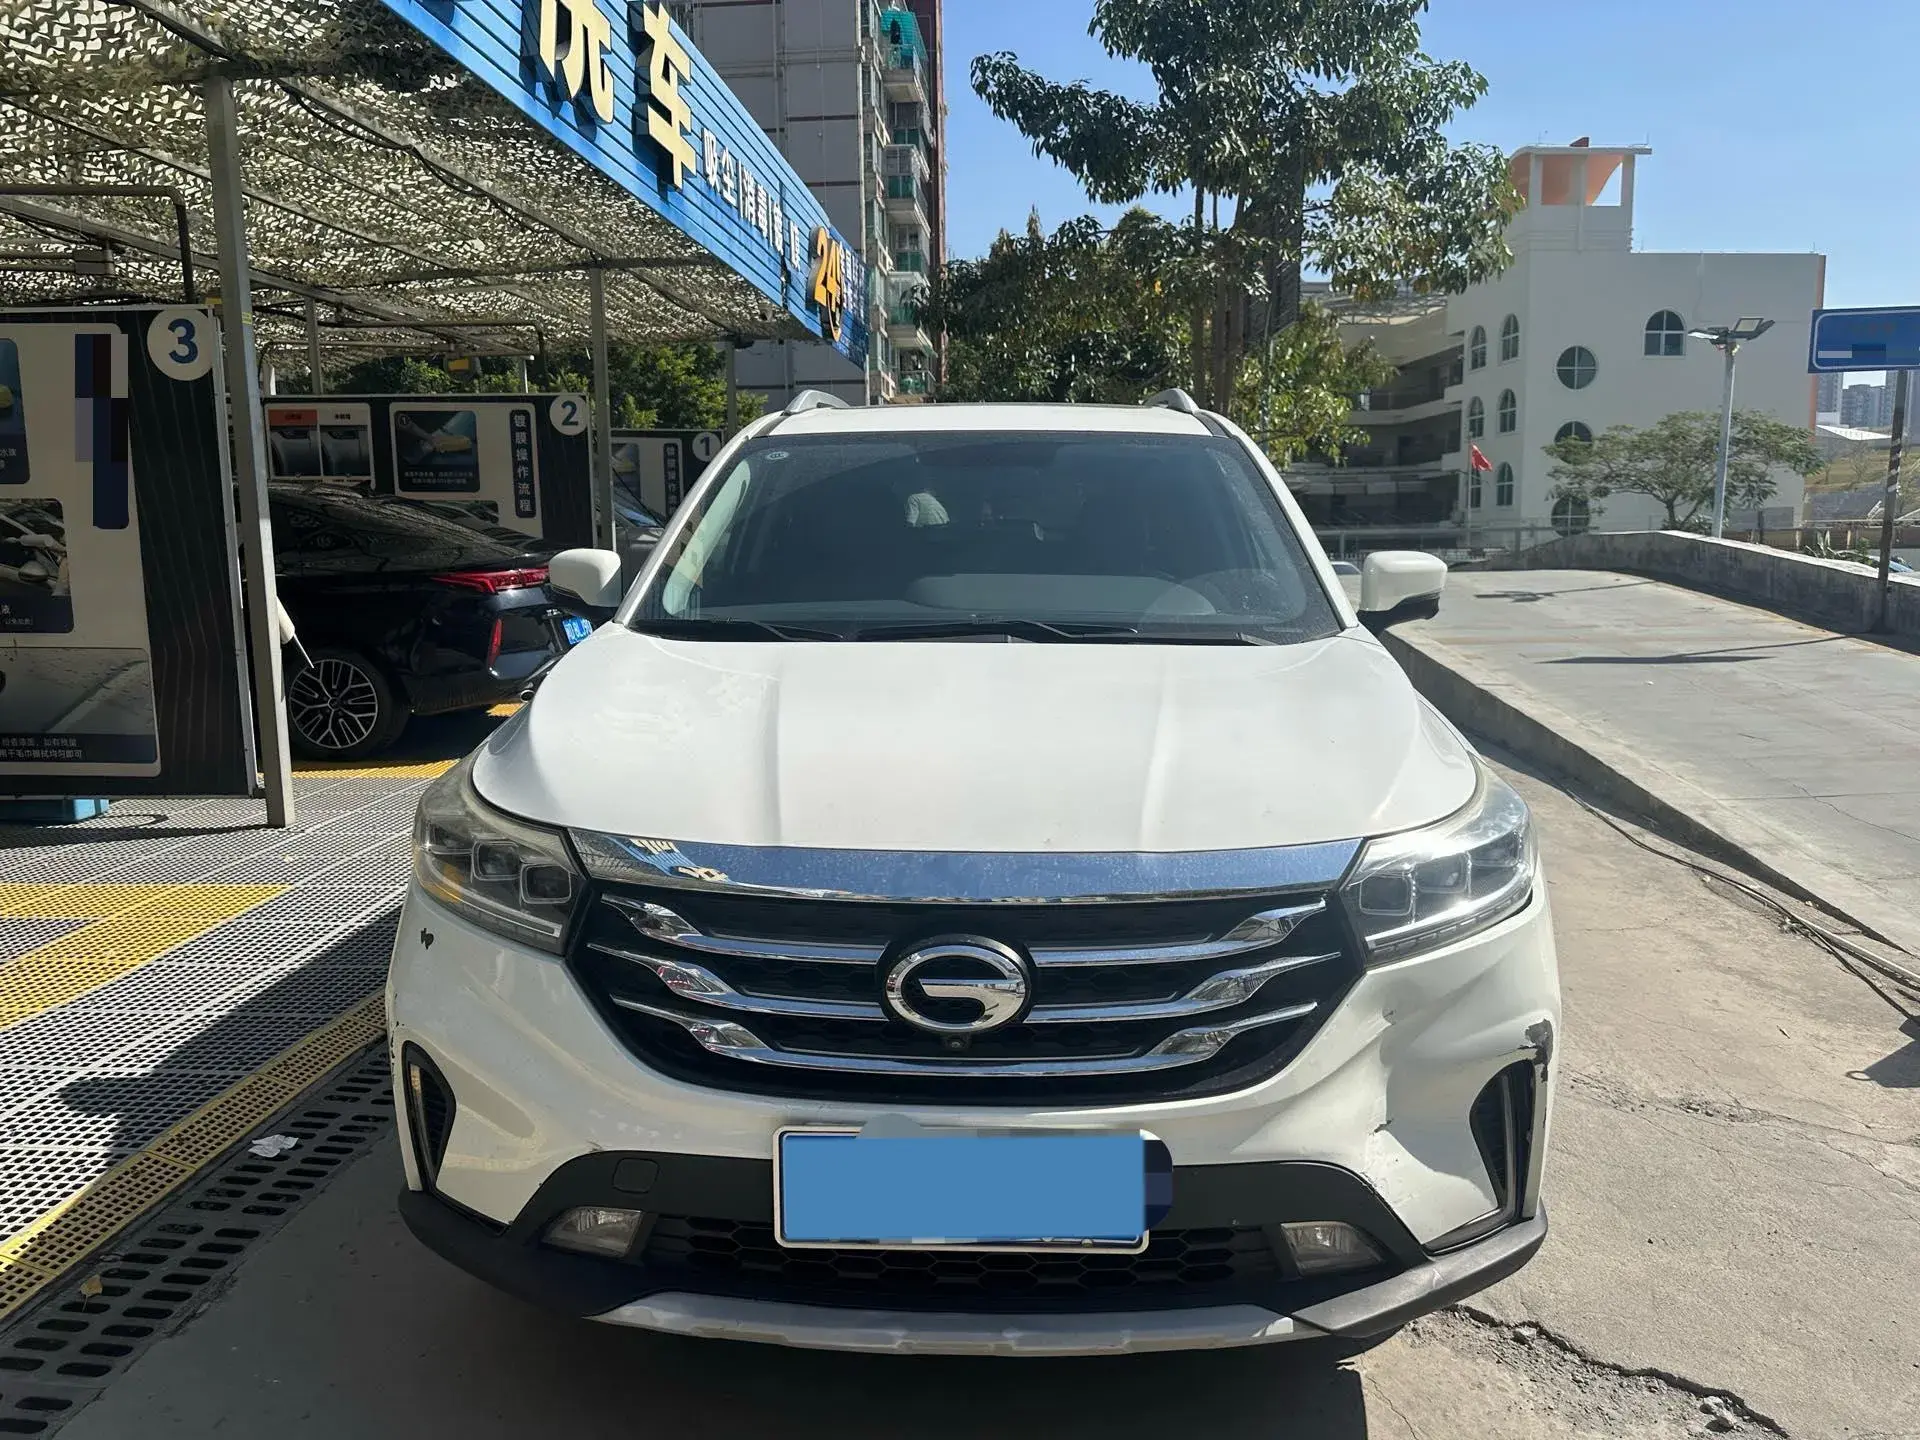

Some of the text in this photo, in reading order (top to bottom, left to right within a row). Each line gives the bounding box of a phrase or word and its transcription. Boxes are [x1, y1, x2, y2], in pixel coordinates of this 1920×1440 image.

[814, 227, 842, 312] 24
[167, 318, 199, 364] 3
[561, 400, 578, 426] 2
[513, 414, 533, 513] 镀膜操作流程
[699, 436, 710, 456] 1
